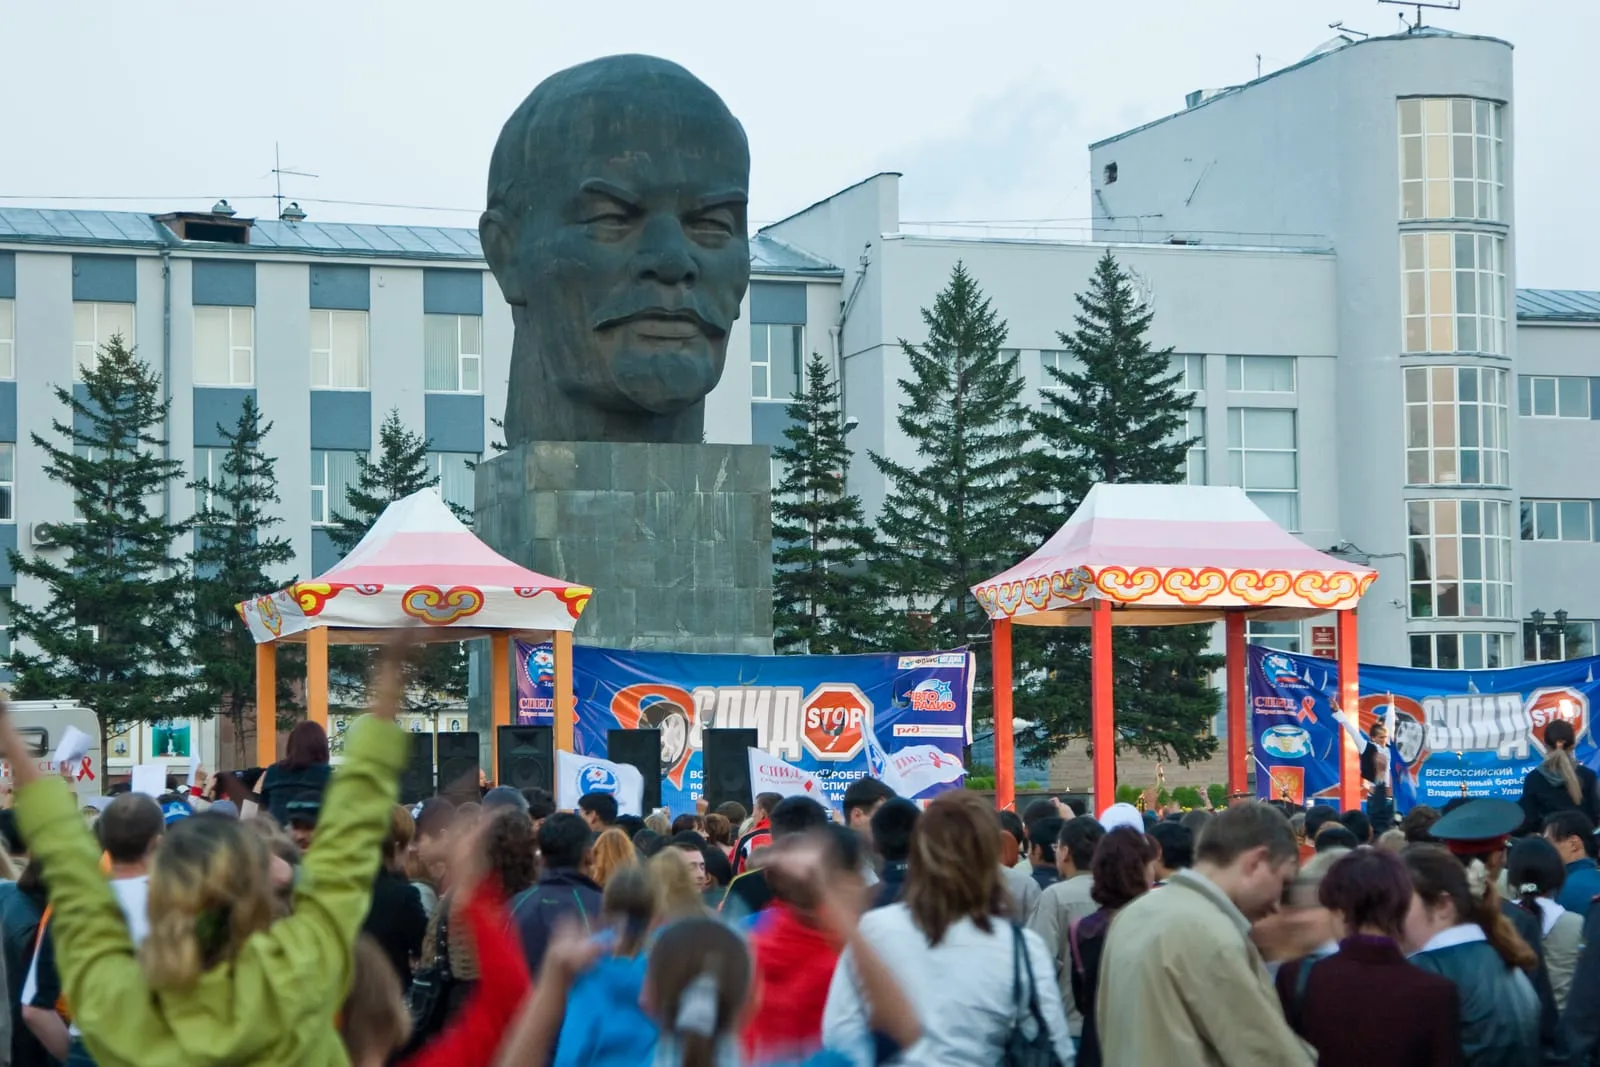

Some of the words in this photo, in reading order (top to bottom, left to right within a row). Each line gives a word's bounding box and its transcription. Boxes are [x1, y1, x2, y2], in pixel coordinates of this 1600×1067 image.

[912, 700, 956, 712] РАДИО
[689, 686, 803, 761] СПИД
[807, 706, 865, 732] STOP
[1532, 706, 1582, 728] STP
[1423, 693, 1529, 759] СПИД
[1425, 767, 1513, 777] ВСЕРОССИЙСКИЙ
[1426, 779, 1493, 788] посвящнный
[1495, 776, 1525, 787] борьб
[1427, 788, 1490, 797] Владивсток
